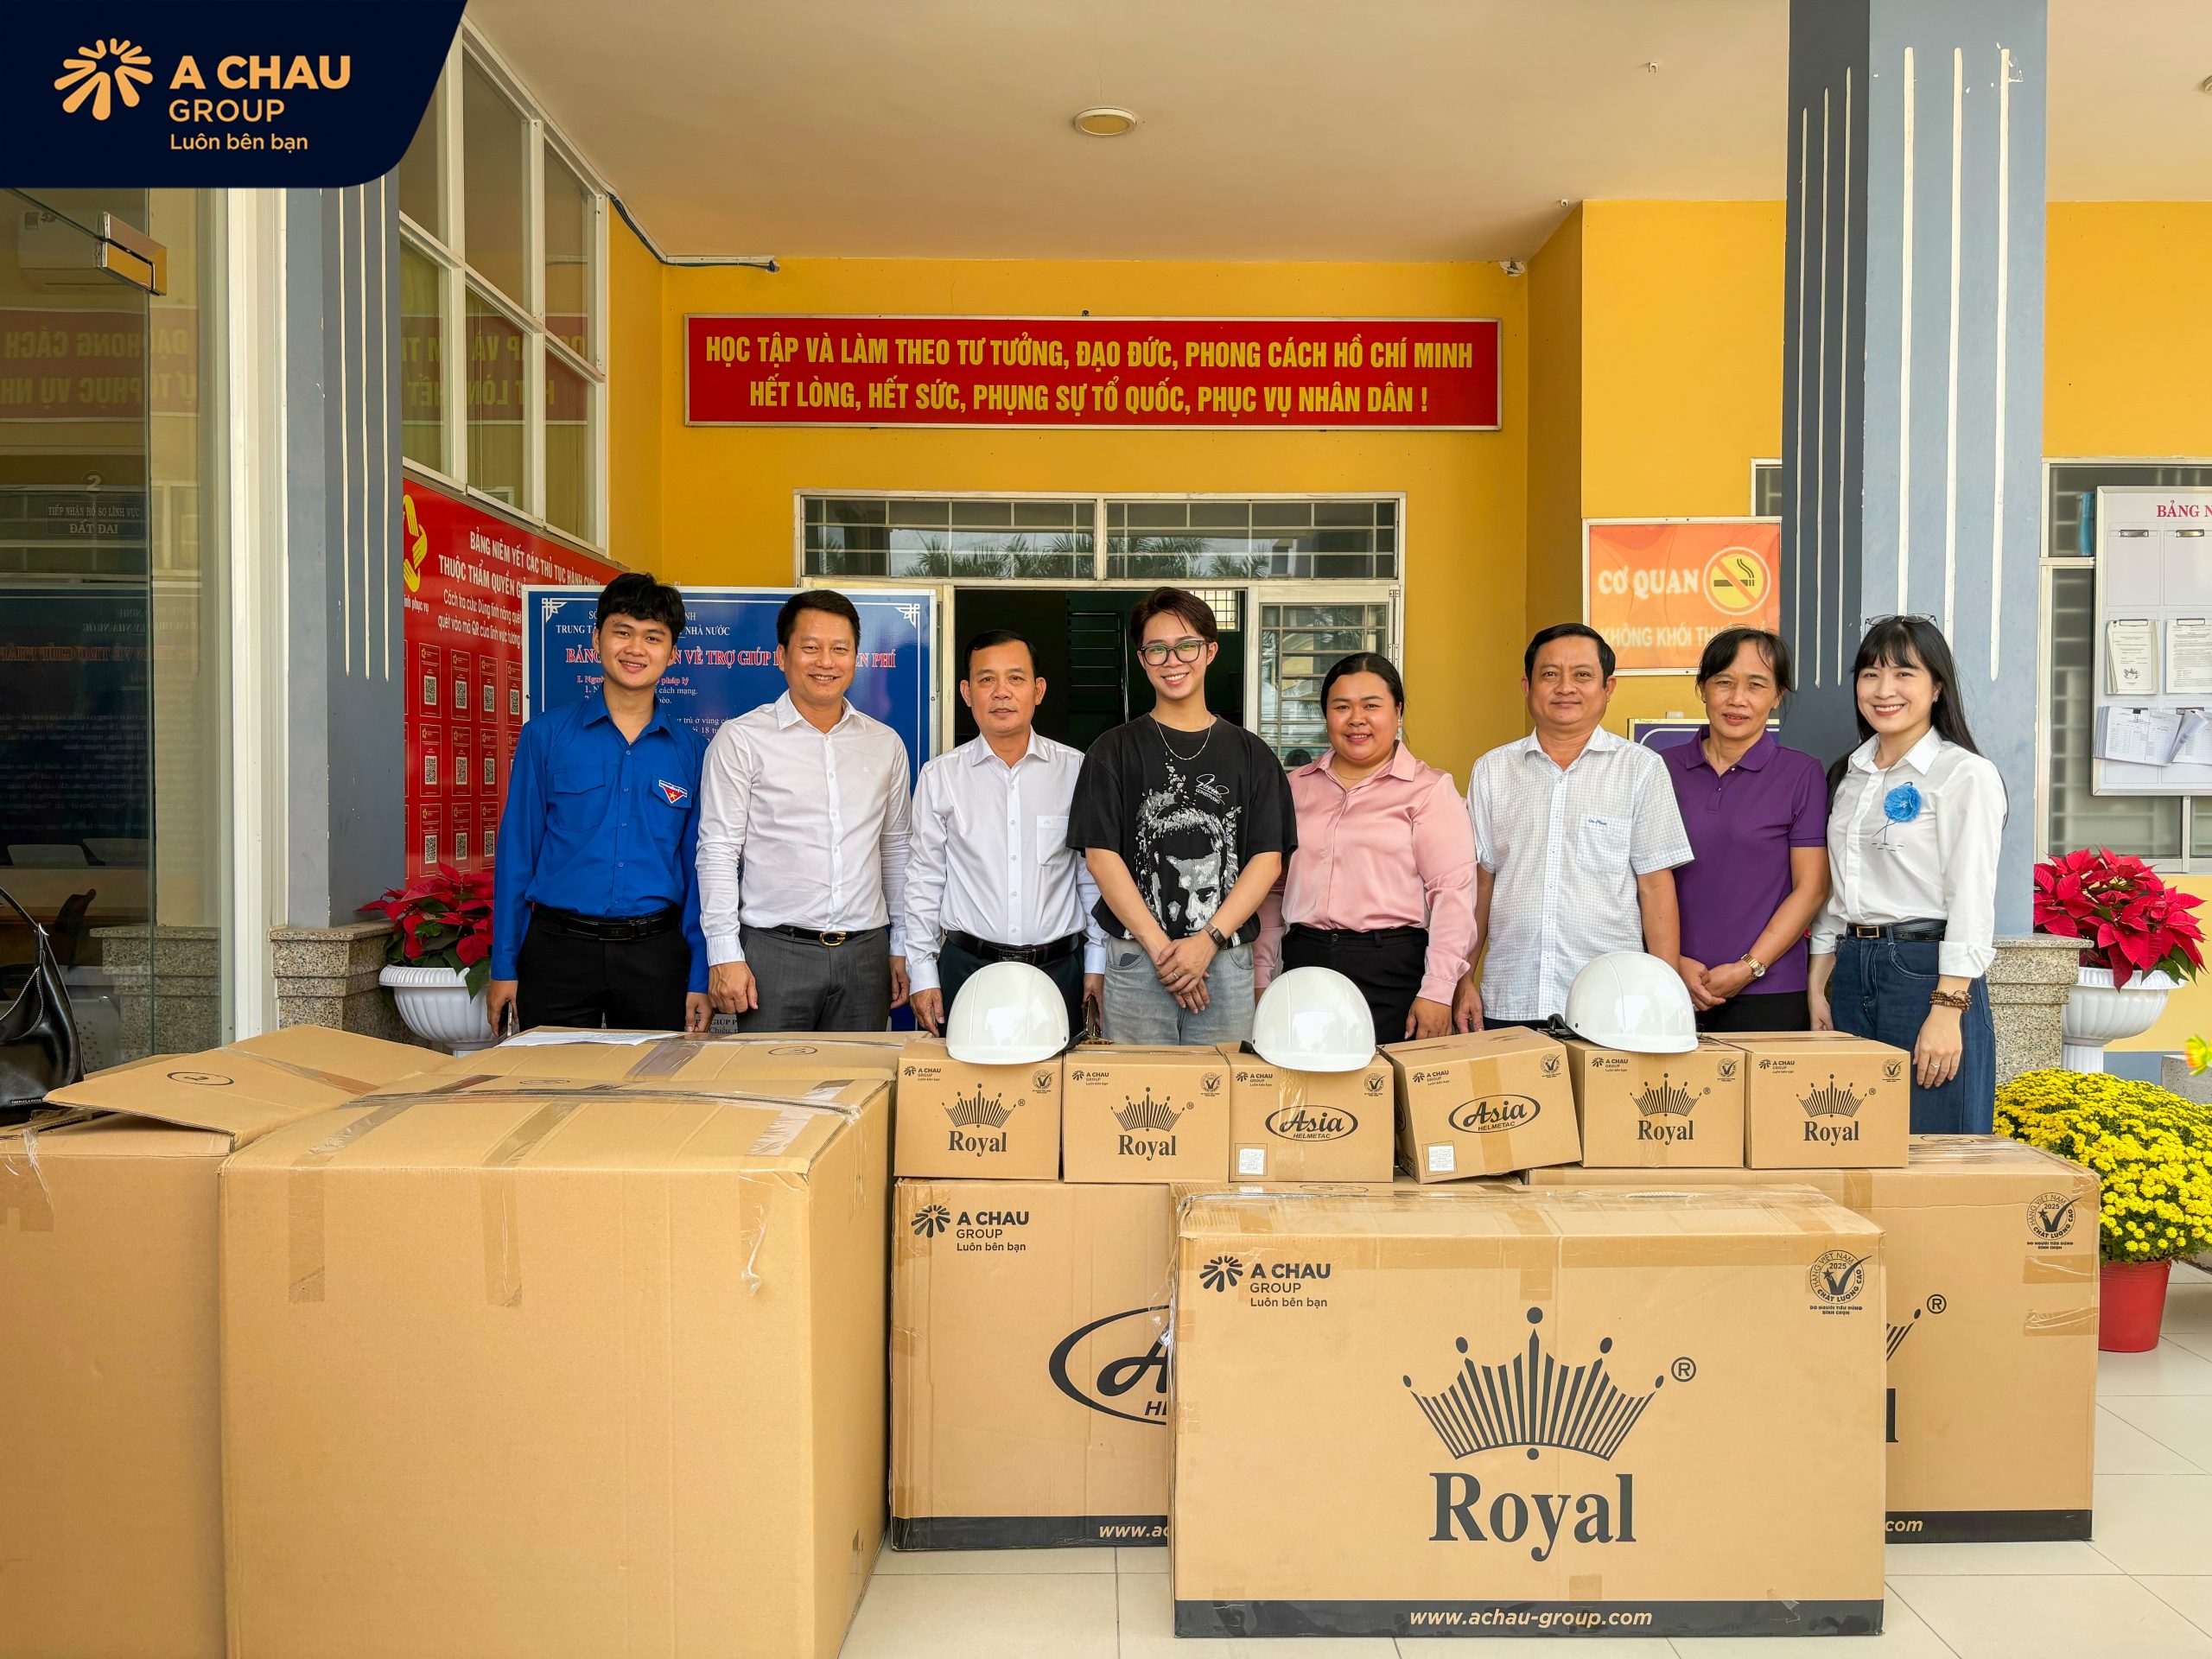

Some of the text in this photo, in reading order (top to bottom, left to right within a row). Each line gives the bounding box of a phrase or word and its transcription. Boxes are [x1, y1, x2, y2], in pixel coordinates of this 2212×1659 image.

[706, 332, 1472, 372] HỌC TẬP VÀ LÀM THEO TƯ TƯỞNG, ĐẠO ĐỨC, PHONG CÁCH HỒ CHÍ MINH
[750, 372, 787, 407] HẾT
[797, 375, 861, 411] LÒNG,
[868, 375, 908, 410] HẾT
[915, 378, 966, 413] SỨC,
[974, 385, 1049, 416] PHỤNG
[1056, 383, 1088, 416] SỰ
[1092, 375, 1120, 412] TỔ
[1126, 377, 1191, 416] QUỐC,
[1198, 386, 1256, 418] PHỤC
[1264, 386, 1293, 418] VỤ
[1299, 381, 1360, 412] NHÂN
[1367, 381, 1413, 412] DÂN
[87, 475, 102, 492] 2
[2157, 499, 2200, 518] BẢNG
[69, 519, 118, 534] ĐẤT ĐAI
[470, 526, 491, 556] BẢNG
[493, 537, 511, 563] NIÊM
[512, 543, 525, 569] YẾT
[526, 550, 539, 574] CÁC
[540, 556, 553, 579] THỦ
[438, 554, 515, 596] THUỘC THẨM QUYỀN
[1598, 565, 1700, 600] CƠ QUAN
[444, 588, 458, 607] Cách
[556, 624, 730, 636] TRUNG NHÀ NƯỚC
[1599, 621, 1652, 647] KHÔNG
[1656, 621, 1691, 647] KHÓI
[684, 645, 703, 665] VỀ
[706, 649, 736, 670] TRỢ
[737, 646, 772, 667] GIÚP
[871, 648, 897, 668] PHÍ
[1280, 1109, 1344, 1132] Asia
[1463, 1100, 1527, 1127] Asia
[1478, 1122, 1515, 1131] HELMETAC
[1637, 1121, 1694, 1145] Royal
[1803, 1121, 1859, 1147] Royal
[948, 1130, 1007, 1157] Royal
[1118, 1135, 1176, 1161] Royal
[957, 1211, 1029, 1225] A CHAU
[957, 1229, 1003, 1239] GROUP
[957, 1243, 1026, 1253] Luôn bên bạn
[1836, 1252, 1854, 1263] NAM
[1250, 1263, 1331, 1279] A CHAU
[1249, 1282, 1301, 1294] GROUP
[1250, 1297, 1327, 1309] Luôn bên bạn
[1429, 1472, 1637, 1562] Royal
[1410, 1609, 1653, 1629] www.achau-group.com
